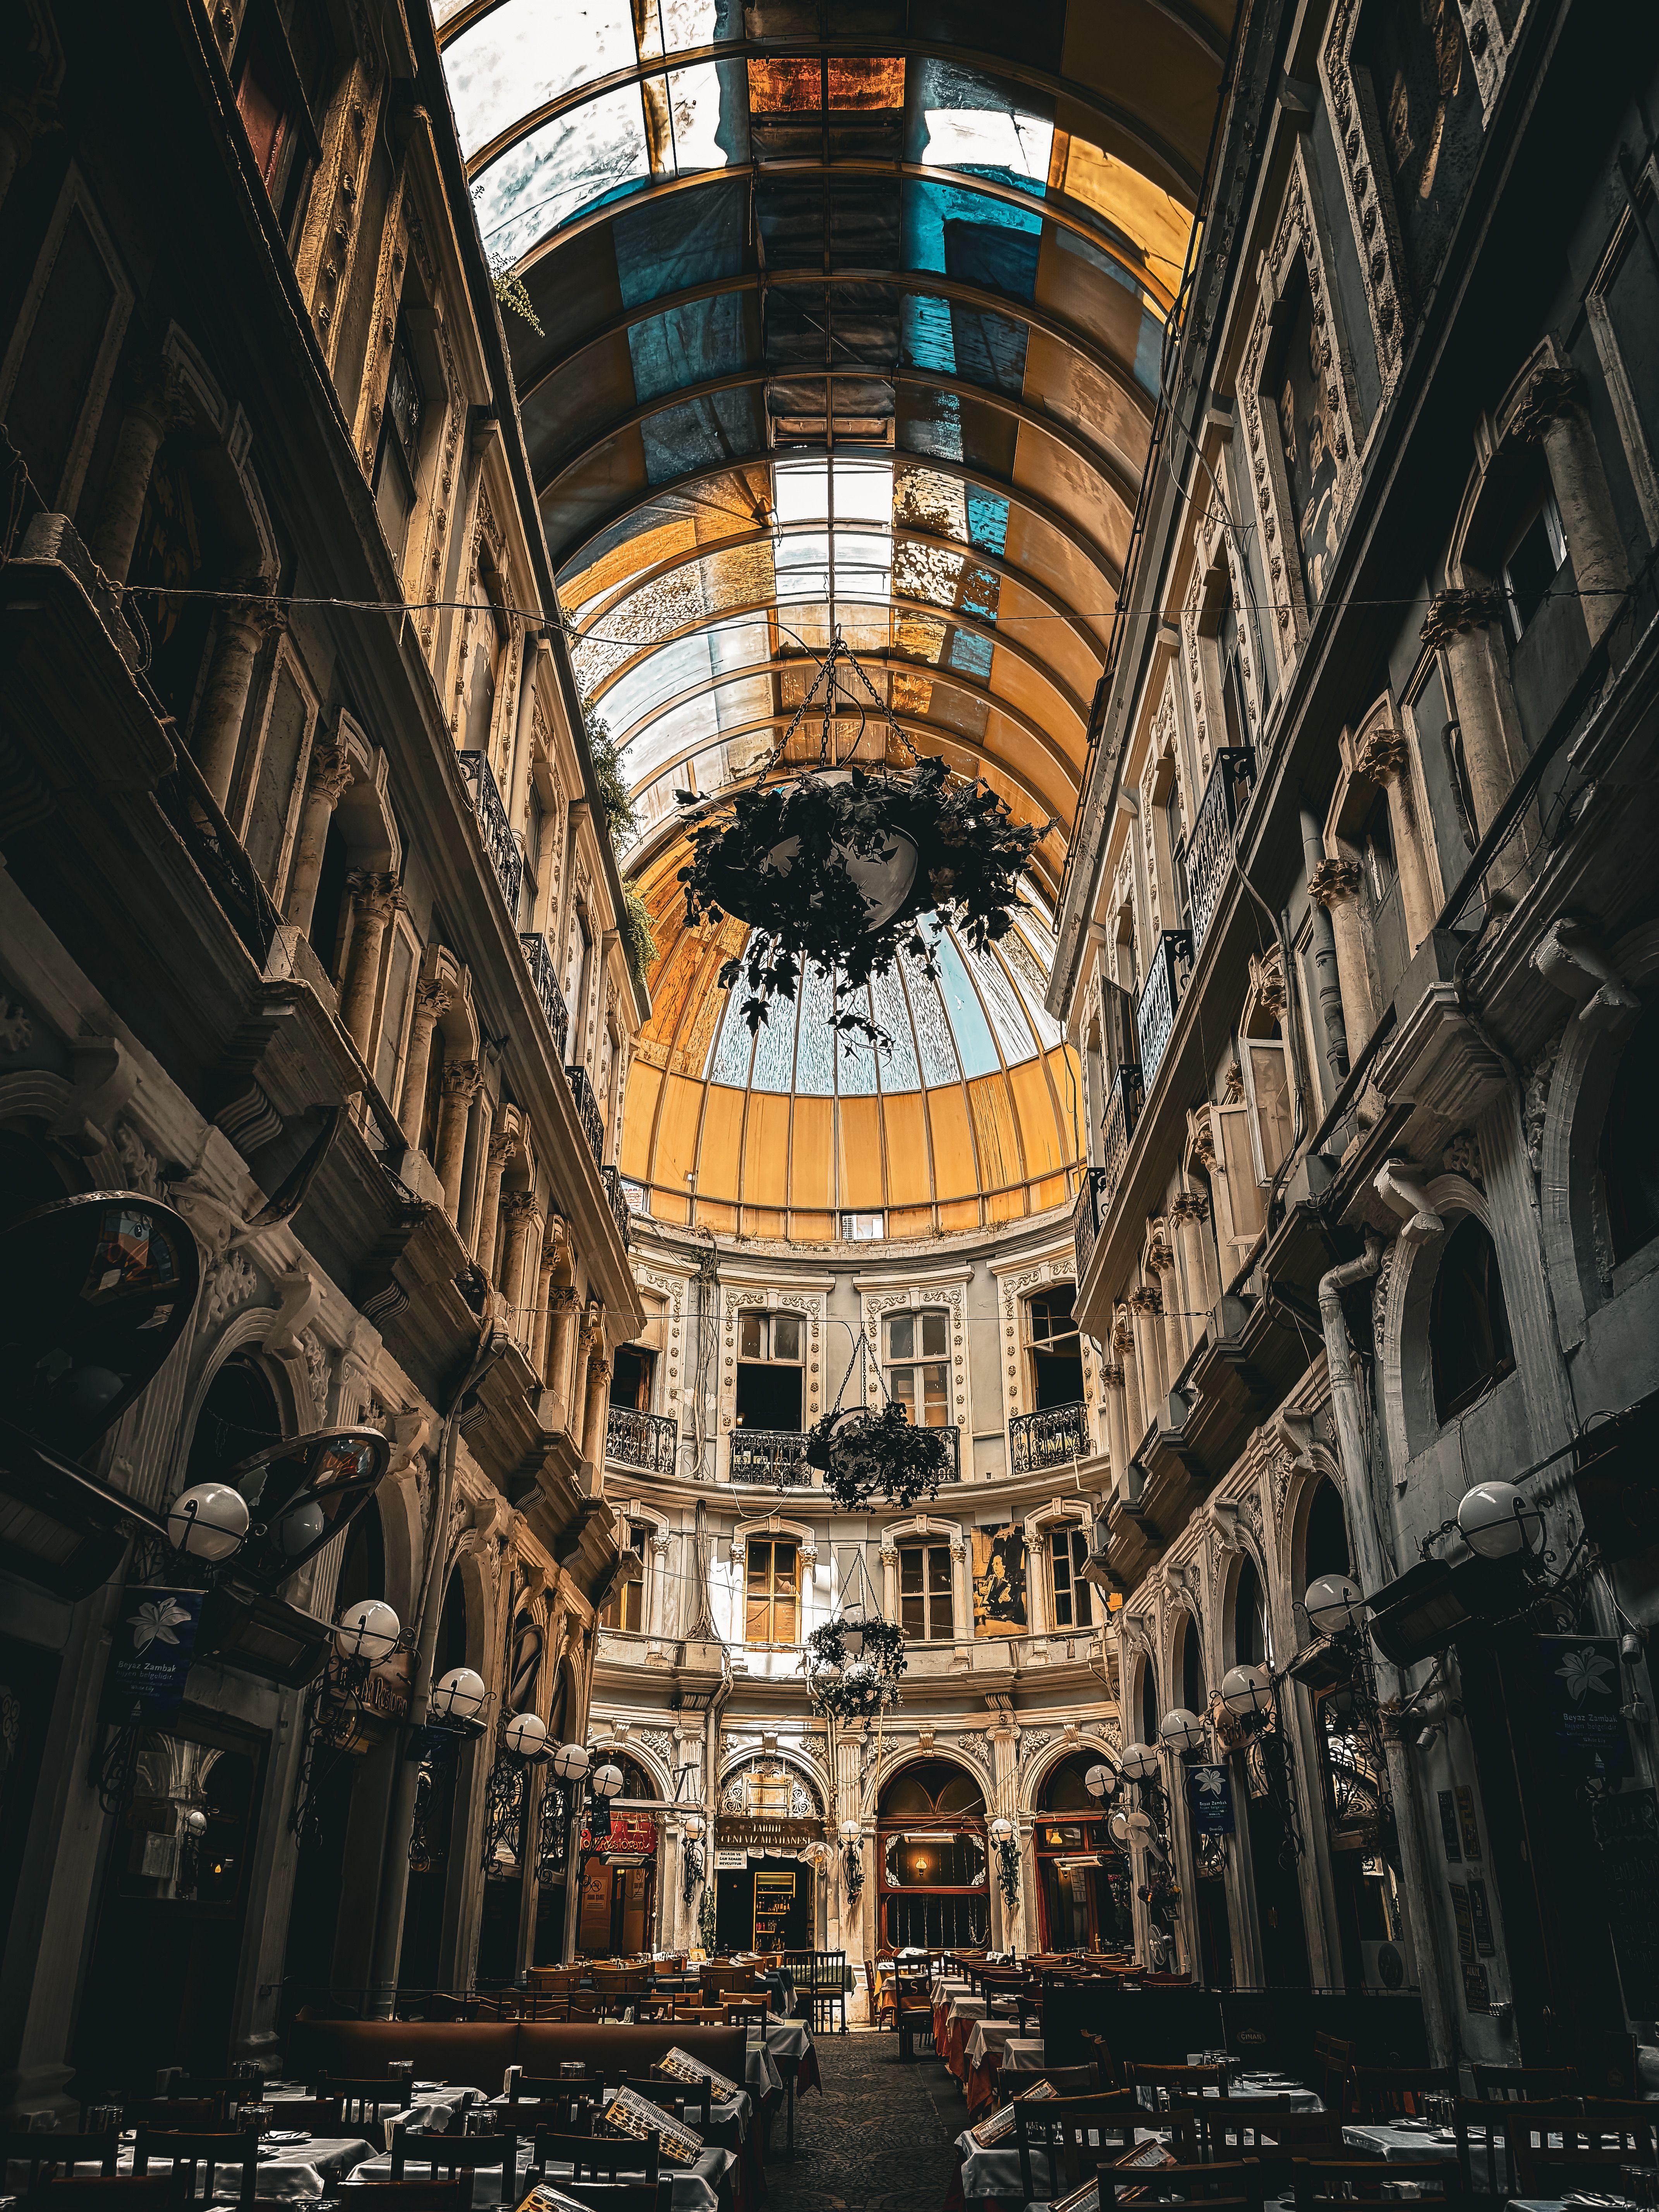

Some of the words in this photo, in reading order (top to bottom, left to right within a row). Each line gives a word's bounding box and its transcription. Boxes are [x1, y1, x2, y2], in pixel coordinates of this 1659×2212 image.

[118, 1661, 141, 1670] Beyaz
[144, 1663, 177, 1672] Zambak
[1563, 1713, 1585, 1722] Beyaz
[1588, 1714, 1618, 1723] Zambak
[1467, 1966, 1480, 1976] ALKOL
